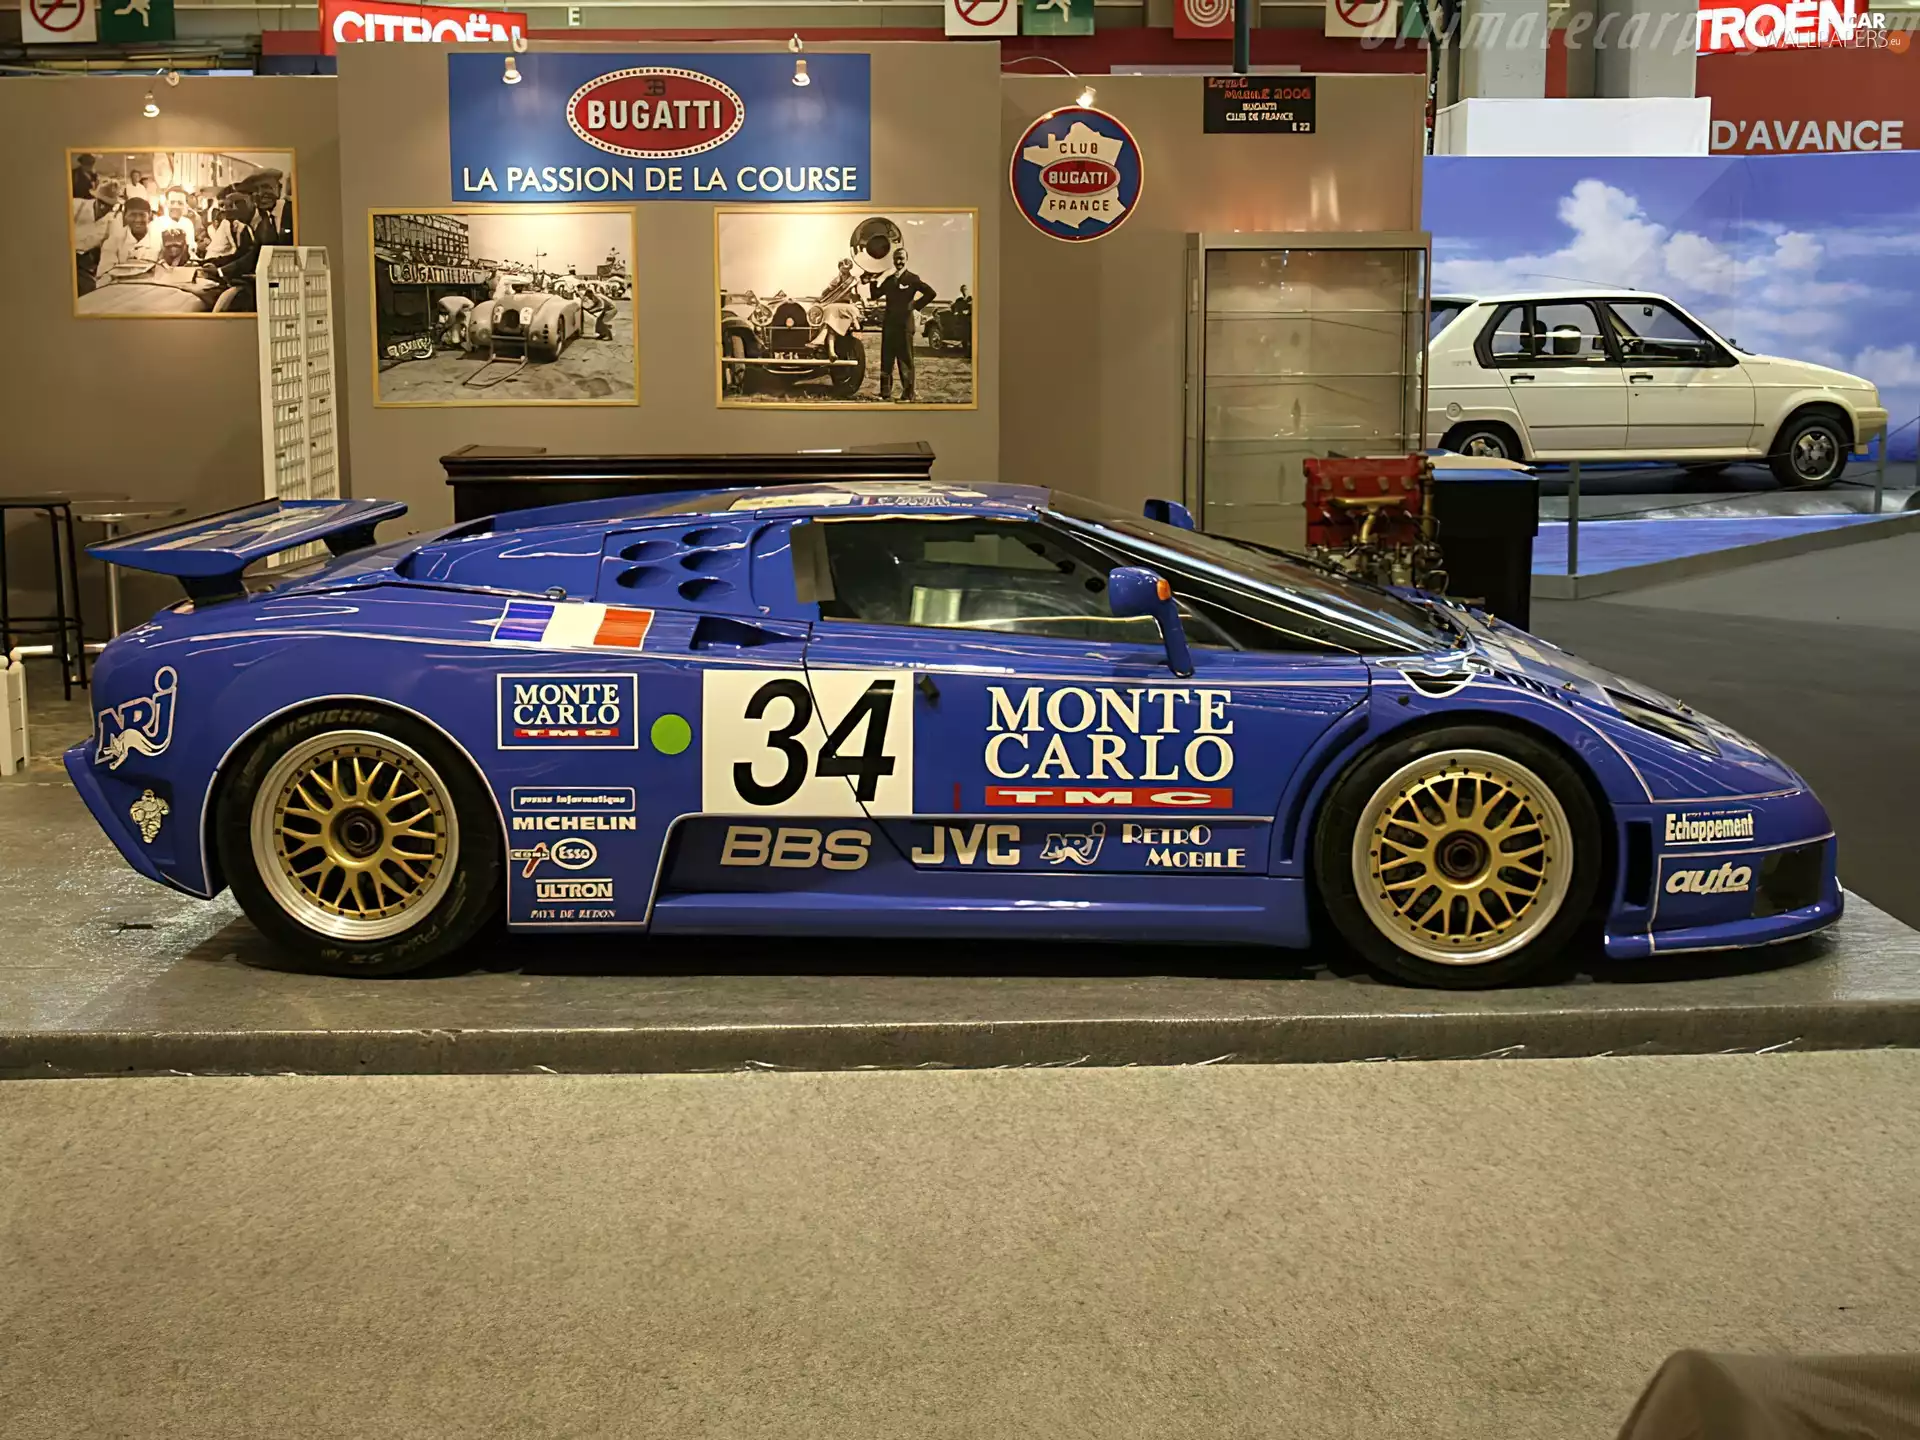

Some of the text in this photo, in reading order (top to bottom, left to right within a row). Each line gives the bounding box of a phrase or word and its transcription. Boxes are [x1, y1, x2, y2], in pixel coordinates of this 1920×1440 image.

[568, 8, 581, 26] E
[587, 100, 722, 131] BUGATTI
[1711, 120, 1904, 151] D'AVANCE
[1059, 143, 1098, 154] CLUB
[463, 166, 857, 193] LA PASSION DE LA COURSE
[1048, 171, 1109, 185] BUGATTI
[1049, 200, 1110, 211] FRANCE
[513, 684, 620, 705] MONTE
[513, 704, 620, 725] CARLO
[985, 686, 1234, 734] MONTE
[733, 678, 897, 806] 34
[984, 733, 1234, 783] CARLO
[998, 790, 1213, 806] TMC
[513, 816, 637, 830] MICHELIN
[1665, 813, 1754, 843] Echappement
[558, 846, 591, 860] Esso
[719, 825, 871, 871] BBS
[911, 823, 1021, 865] JVC
[536, 883, 613, 898] ULTRON
[1665, 861, 1753, 896] auto
